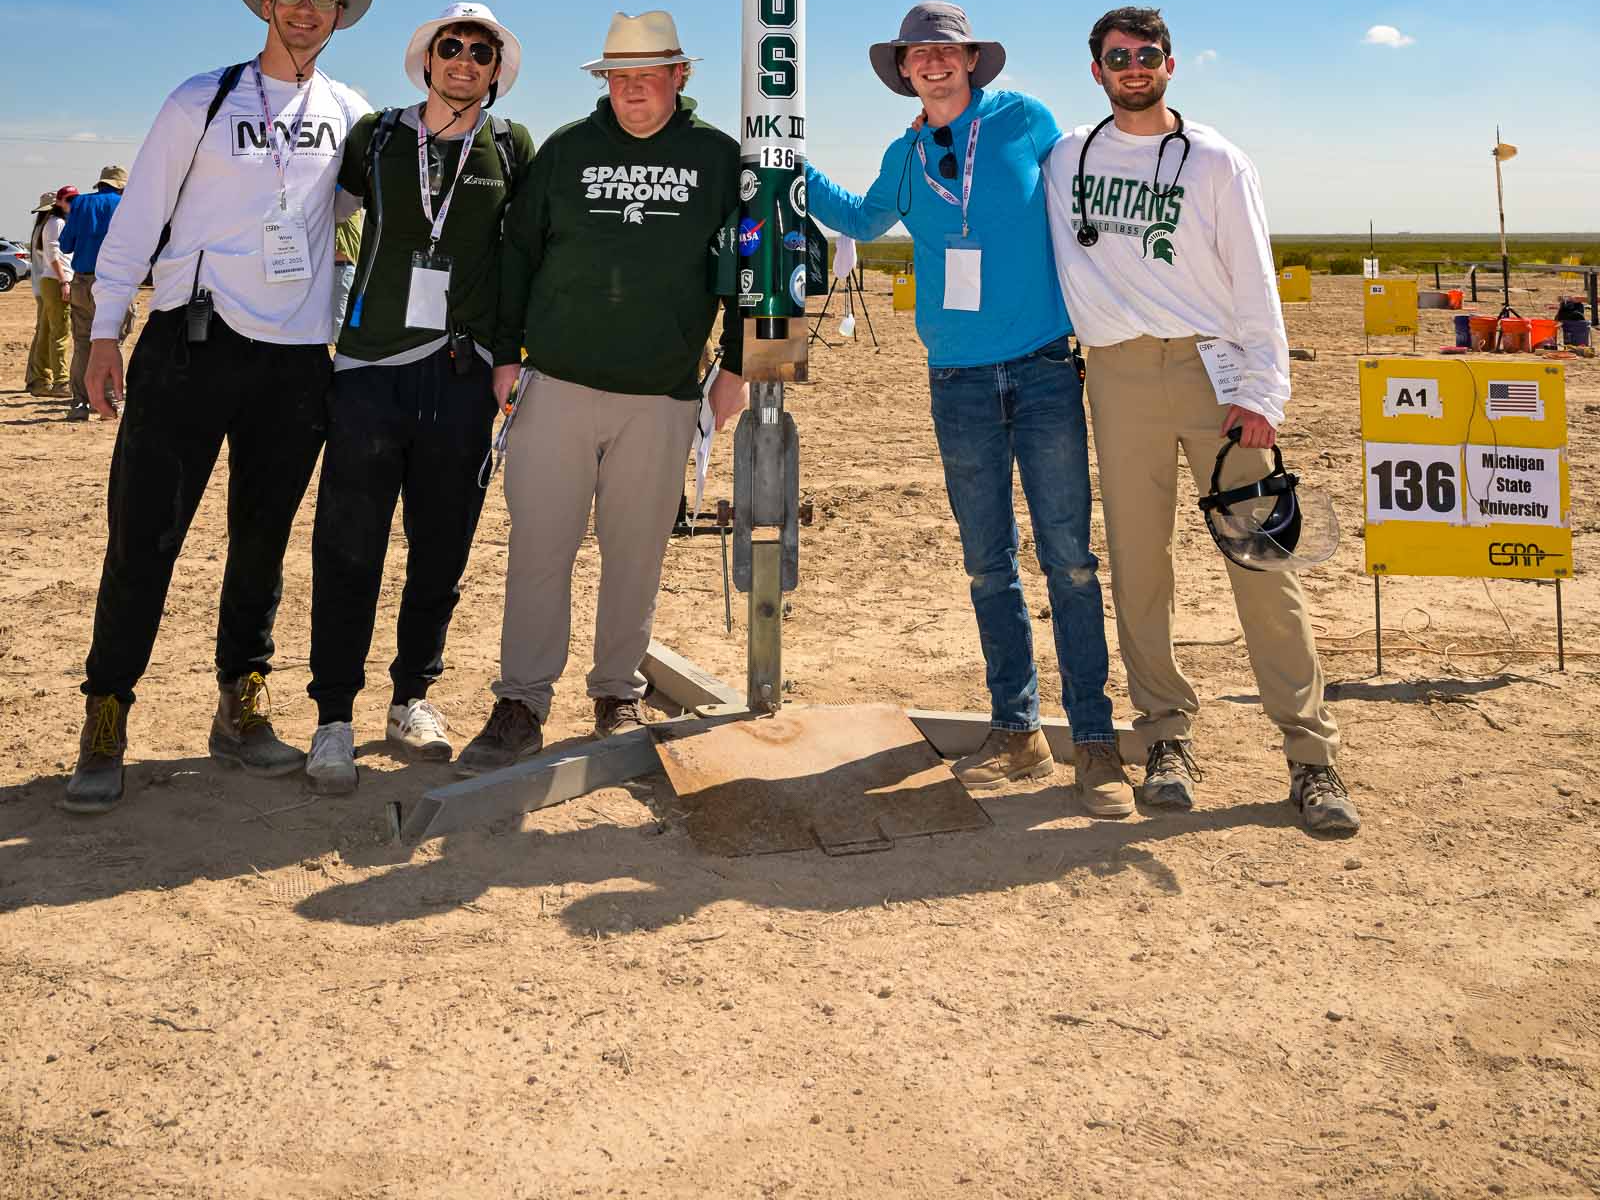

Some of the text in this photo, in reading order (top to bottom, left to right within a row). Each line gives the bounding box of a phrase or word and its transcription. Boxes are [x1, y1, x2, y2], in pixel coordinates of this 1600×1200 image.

[746, 115, 783, 139] MK
[763, 147, 793, 168] 136
[581, 166, 698, 187] SPARTAN
[585, 183, 689, 202] STRONG
[1072, 174, 1184, 225] SPARTANS
[1115, 224, 1139, 235] 1855
[1396, 388, 1428, 407] A1
[1482, 453, 1545, 471] Michigan
[1371, 460, 1456, 513] 136
[1496, 476, 1532, 494] State
[1480, 499, 1549, 519] University
